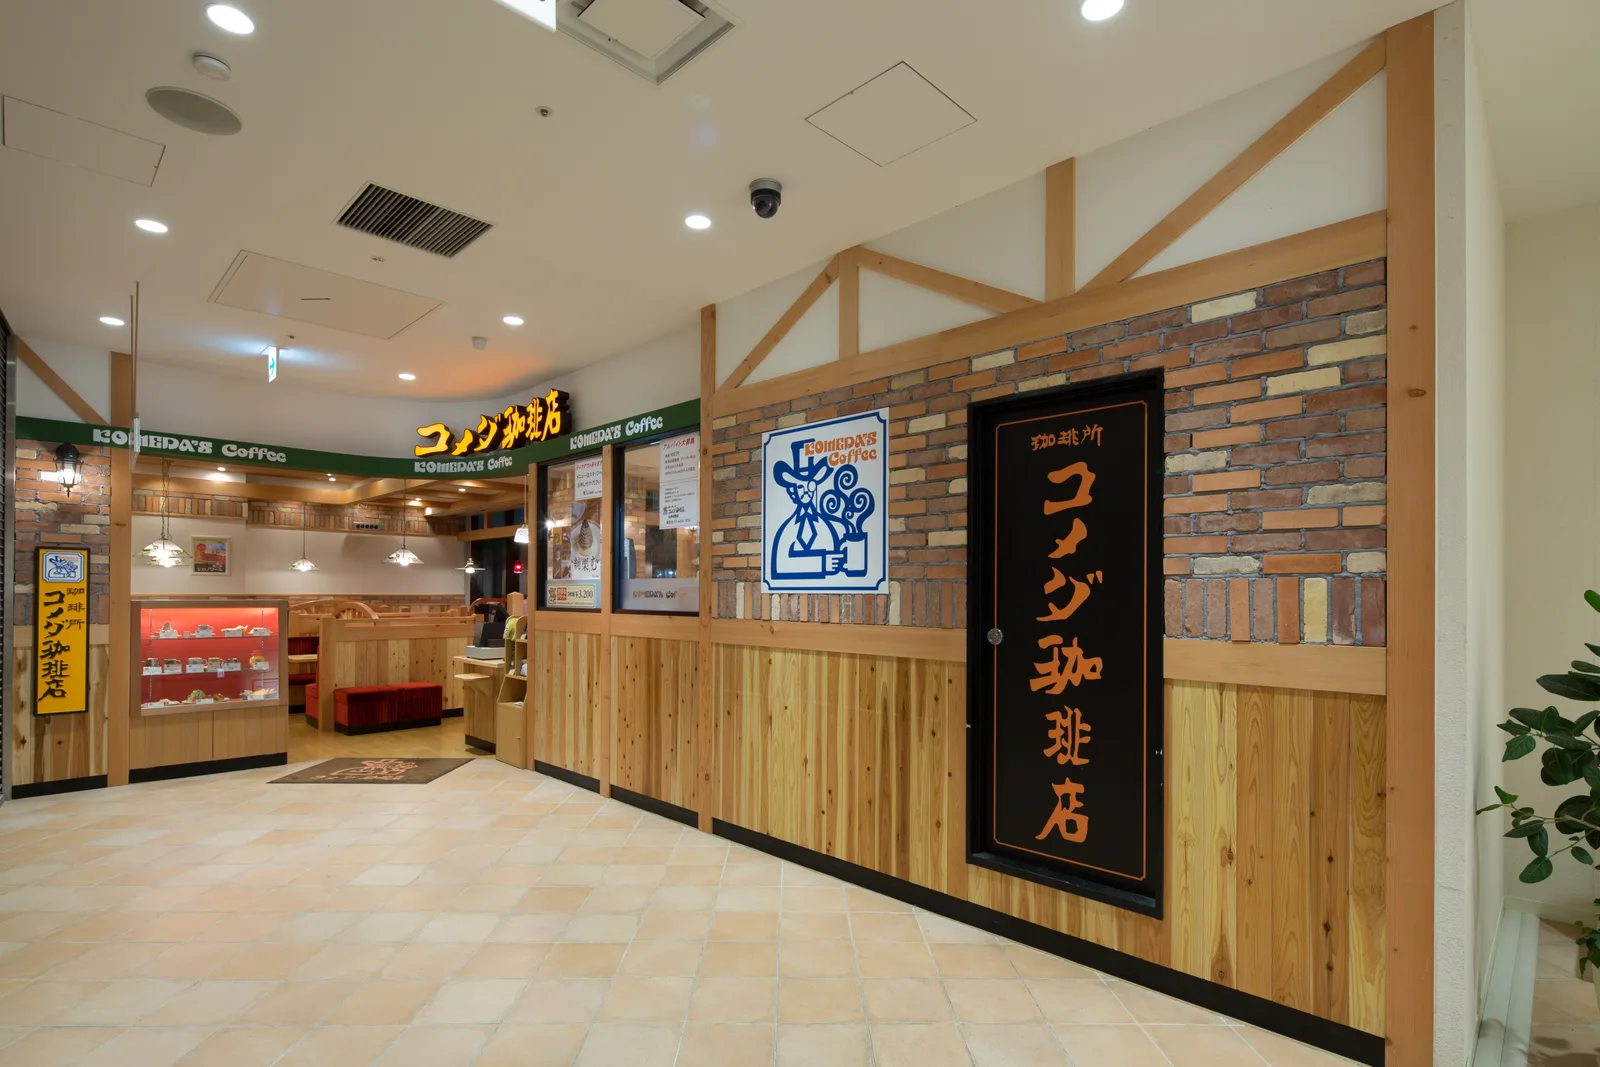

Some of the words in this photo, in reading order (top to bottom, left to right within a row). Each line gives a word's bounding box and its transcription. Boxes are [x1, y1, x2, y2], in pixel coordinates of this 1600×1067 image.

[413, 388, 563, 457] コメダ珈琲店
[569, 424, 621, 451] KOMEDA'S
[625, 416, 663, 437] Coffee
[804, 431, 877, 456] KOMEDA'S
[1031, 423, 1104, 451] 珈琲所
[221, 443, 287, 463] Coffee
[414, 460, 484, 474] KOMEDA'S
[487, 456, 513, 471] Coffee
[828, 447, 877, 467] Coffee
[38, 590, 71, 702] コメダ珈琲店
[1029, 461, 1103, 843] コメダ珈琲店
